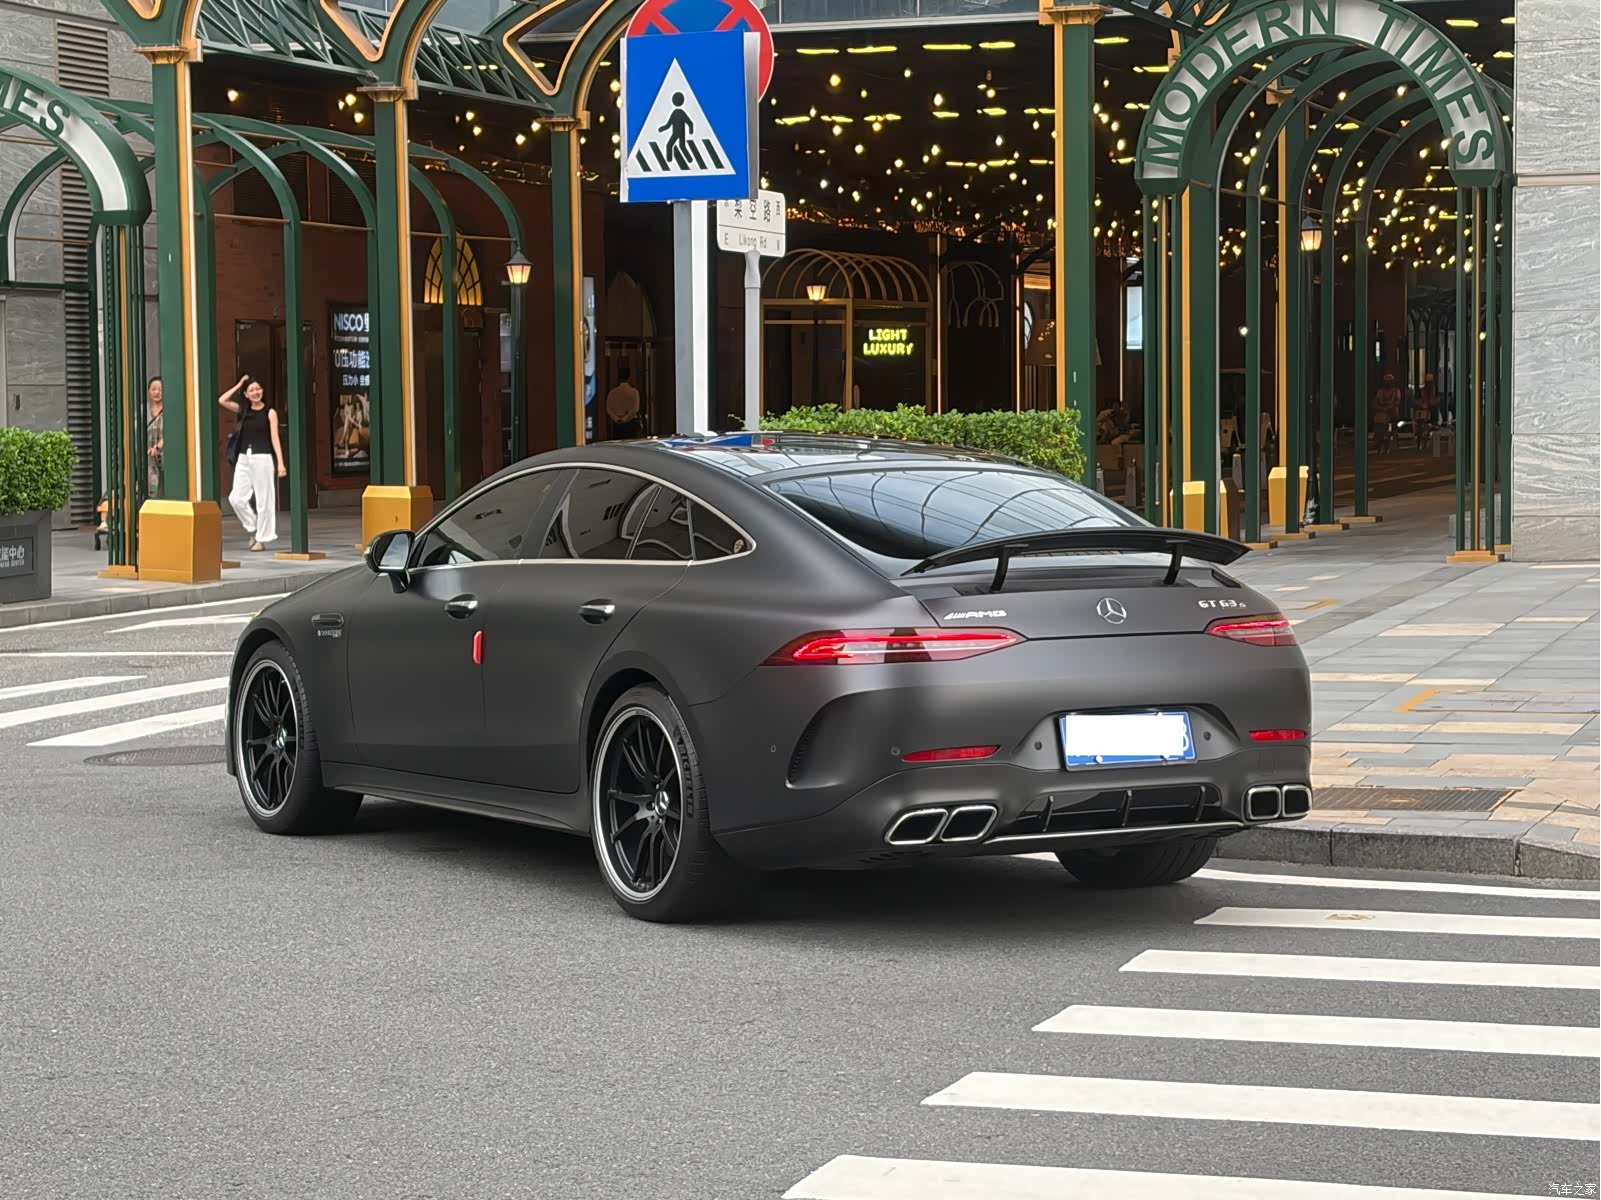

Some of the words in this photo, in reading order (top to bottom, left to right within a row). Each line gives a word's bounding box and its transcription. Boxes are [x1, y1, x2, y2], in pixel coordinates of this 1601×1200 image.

[1142, 1, 1336, 168] MODERN
[1373, 7, 1495, 165] TIMES
[0, 72, 71, 137] ES
[334, 313, 364, 332] NISCO
[869, 328, 908, 341] LIGHT
[863, 342, 914, 356] LUXURY
[1198, 599, 1217, 609] GT
[964, 609, 1007, 619] AMG
